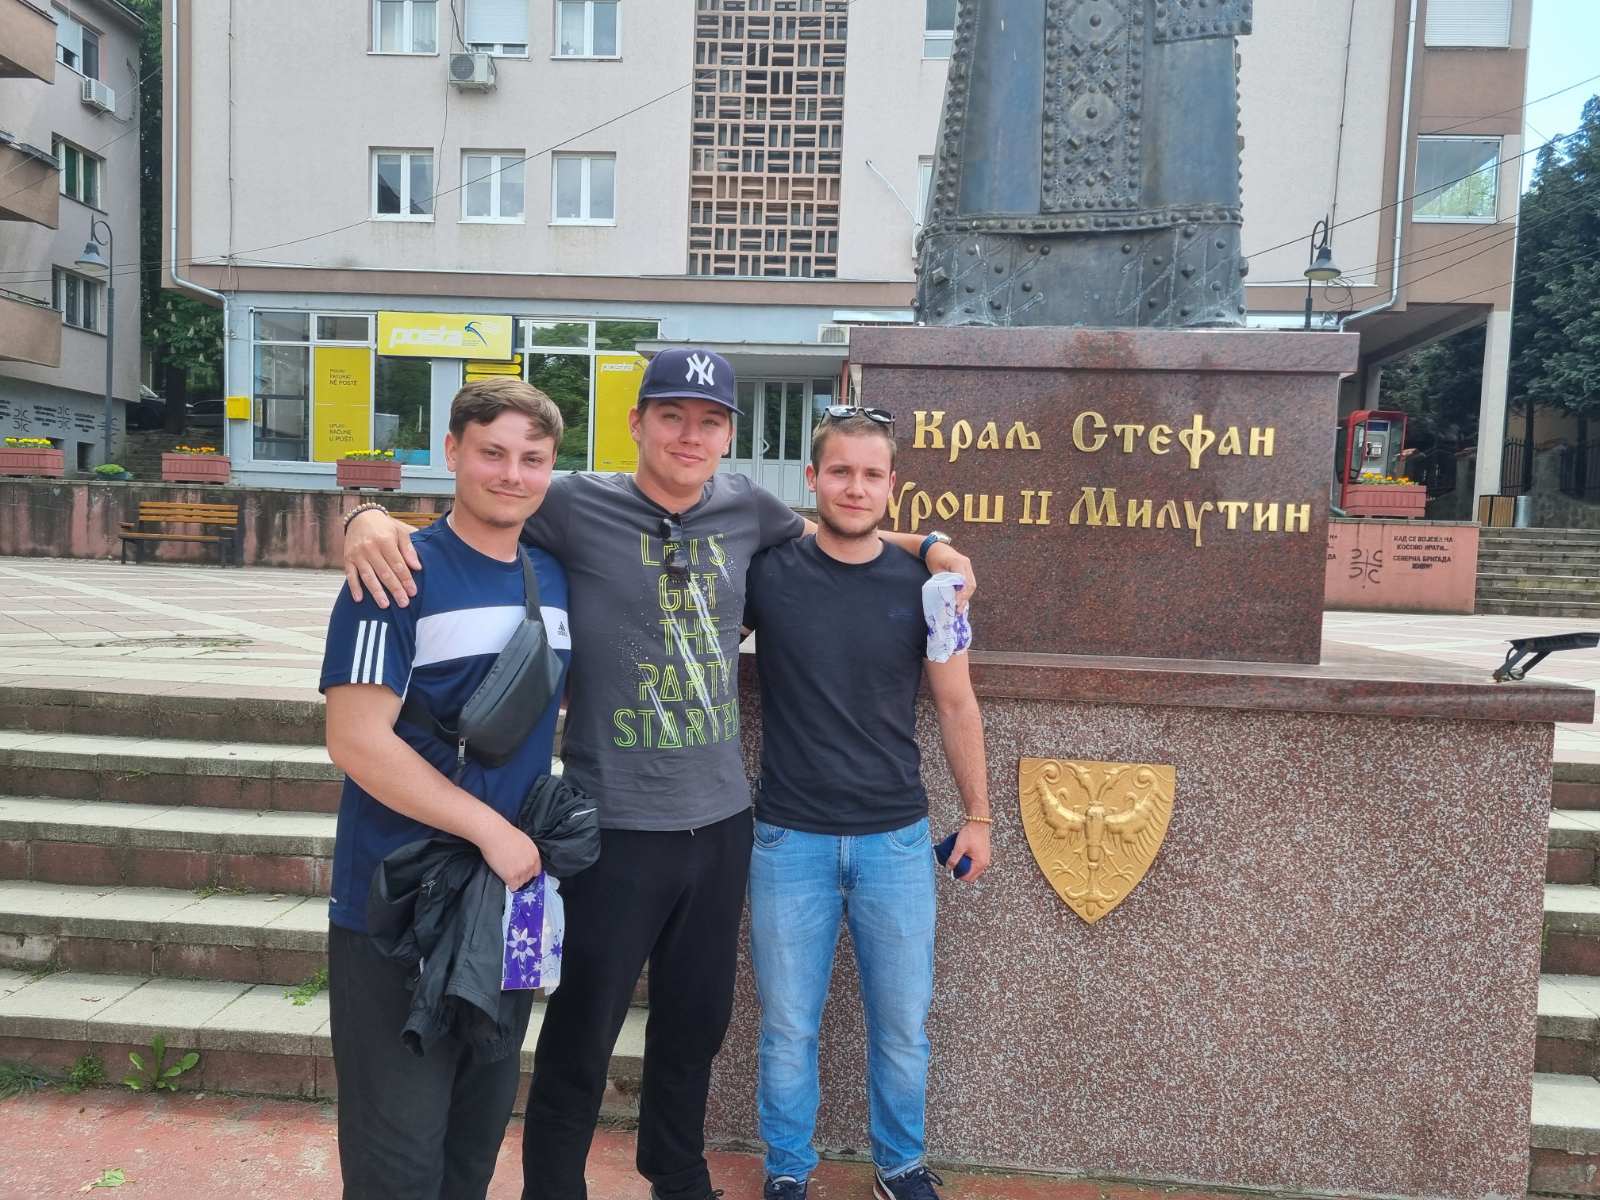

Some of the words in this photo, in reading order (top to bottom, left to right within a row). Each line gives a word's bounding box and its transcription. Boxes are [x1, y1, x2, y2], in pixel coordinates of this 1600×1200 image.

[685, 353, 715, 386] NY
[912, 410, 1042, 463] Краљ
[1072, 411, 1276, 470] Стефан
[1068, 487, 1312, 547] Милутин
[659, 617, 721, 656] THE
[638, 658, 733, 701] PARTY
